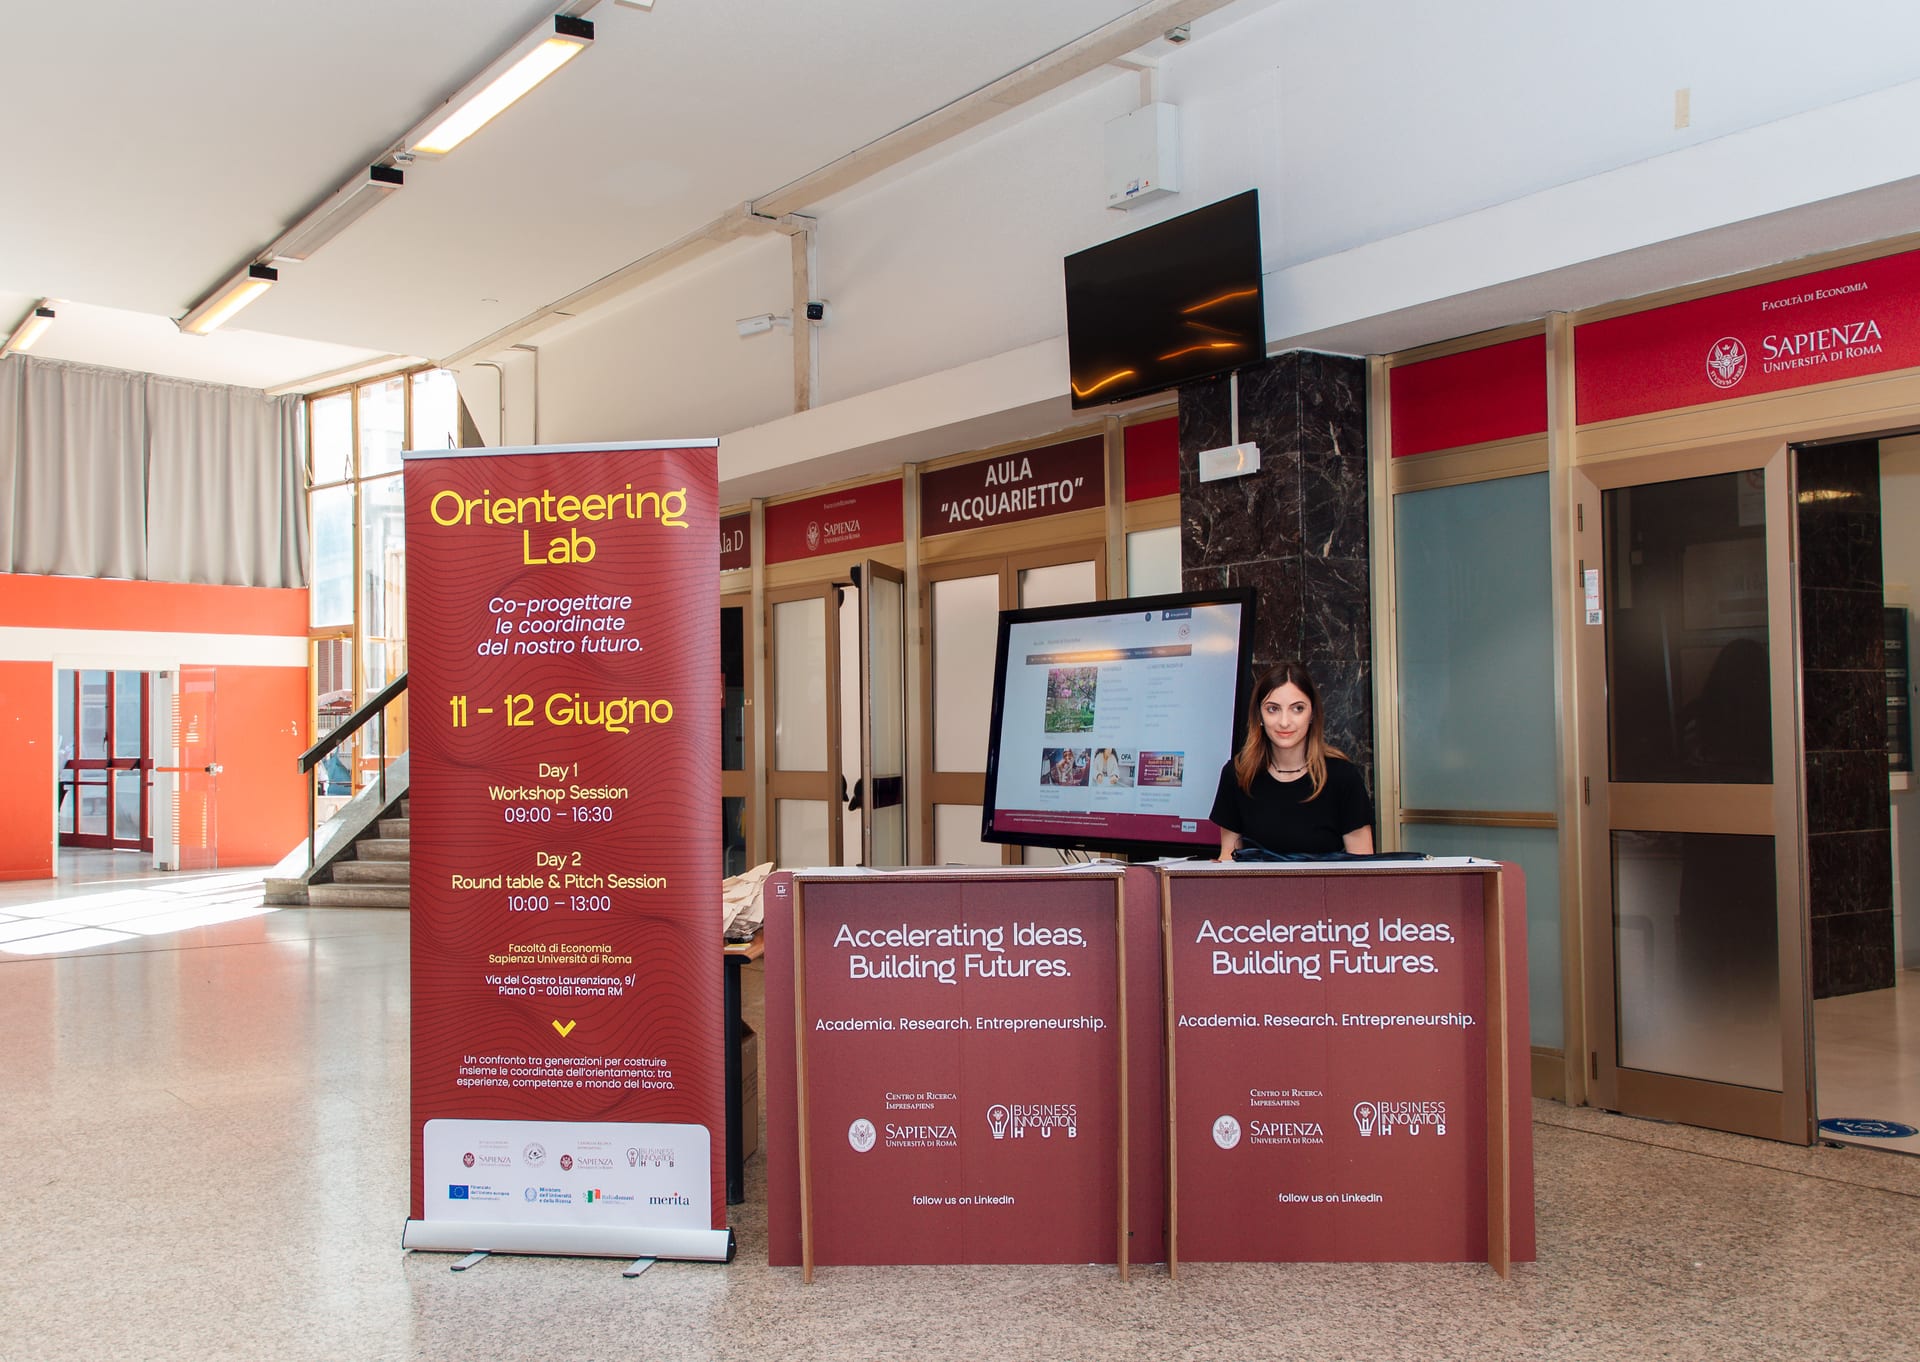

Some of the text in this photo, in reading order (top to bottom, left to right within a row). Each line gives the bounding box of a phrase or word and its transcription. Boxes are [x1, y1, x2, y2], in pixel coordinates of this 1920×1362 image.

[1763, 320, 1882, 360] SAPIENZA
[984, 458, 1033, 487] AULA
[430, 484, 689, 529] Orienteering
[523, 528, 596, 565] Lab
[734, 530, 744, 551] D
[488, 594, 632, 620] Co-progettare
[496, 615, 626, 635] le coordinate
[477, 636, 644, 656] del nostro futuro.
[450, 695, 467, 728] 11
[504, 694, 534, 727] 12
[544, 693, 673, 734] Giugno
[539, 762, 578, 781] Day 1
[488, 785, 628, 804] Workshop Session
[504, 806, 551, 823] 09:00
[572, 806, 613, 823] 16:30
[536, 852, 582, 871] Day 2
[452, 874, 667, 890] Round table & Pitch Session
[508, 896, 549, 912] 10:00
[570, 896, 611, 912] 13:00
[833, 922, 1088, 952] Accelerating Ideas,
[1196, 918, 1456, 949] Accelerating Ideas,
[509, 943, 612, 953] Facoltà di Economia
[488, 954, 632, 966] Sapienza Università di Roma
[1213, 950, 1439, 981] Building Futures.
[850, 954, 1072, 985] Building Futures.
[485, 974, 636, 987] Via del Castro Laurenziano, 9/
[498, 986, 526, 996] Piano
[529, 986, 536, 996] 0
[546, 987, 572, 996] 00161
[575, 987, 605, 996] Roma
[608, 987, 623, 996] RM
[815, 1017, 1107, 1033] Academia. Research. Entrepreneurship.
[1178, 1013, 1476, 1029] Academia. Research. Entrepreneurship.
[464, 1055, 667, 1069] Un confronto tra generazioni per costruire
[459, 1067, 497, 1076] insieme
[500, 1067, 508, 1076] le
[510, 1067, 564, 1077] coordinate
[658, 1069, 672, 1078] tra
[457, 1078, 675, 1089] esperienze, competenze e mondo del lavoro.
[1014, 1104, 1077, 1116] BUSINESS
[1382, 1102, 1446, 1114] BUSINESS
[1014, 1116, 1077, 1128] INNOVATION
[1382, 1113, 1446, 1125] INNOVATION
[885, 1124, 957, 1139] SAPIENZA
[1251, 1121, 1324, 1136] SAPIENZA
[650, 1192, 690, 1206] merita
[913, 1195, 1015, 1205] follow us on LinkedIn
[1279, 1193, 1383, 1203] follow us on LinkedIn
